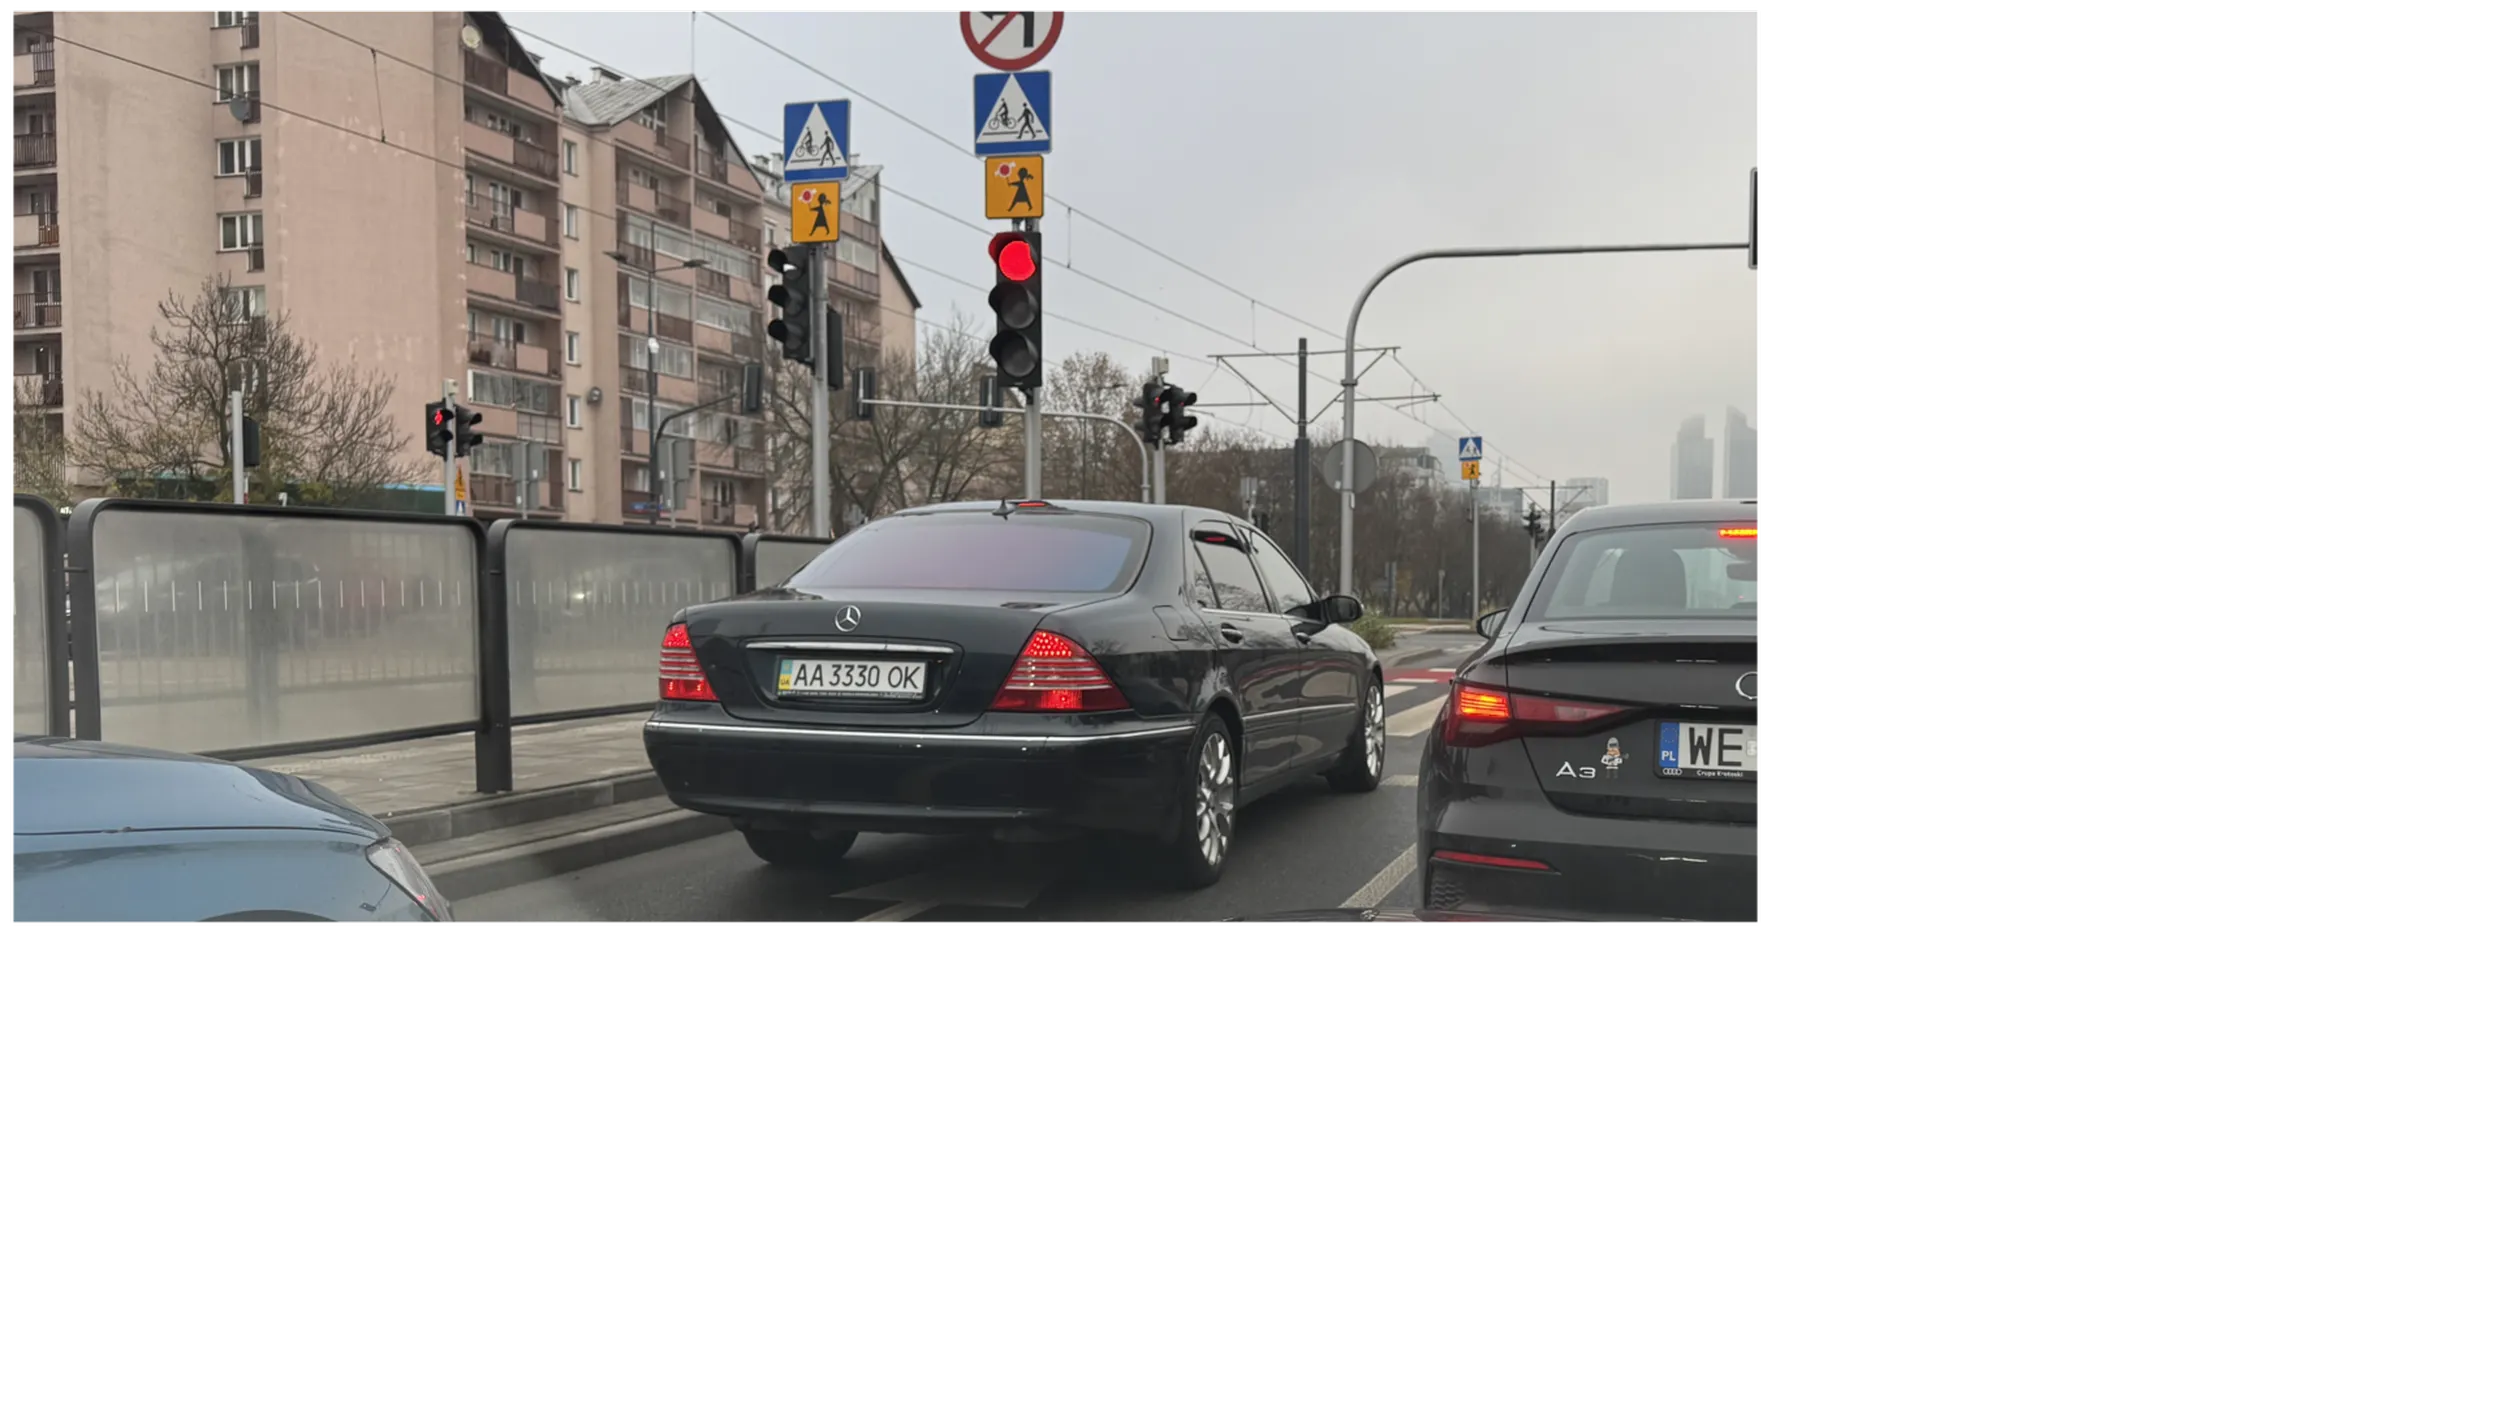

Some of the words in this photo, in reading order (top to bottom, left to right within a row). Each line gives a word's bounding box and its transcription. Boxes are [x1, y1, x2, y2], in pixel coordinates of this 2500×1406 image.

[793, 663, 824, 687] AA
[828, 663, 881, 688] 3330
[887, 665, 921, 690] OK
[1661, 750, 1676, 762] PL
[1688, 726, 1743, 767] WE
[1555, 760, 1597, 779] A3
